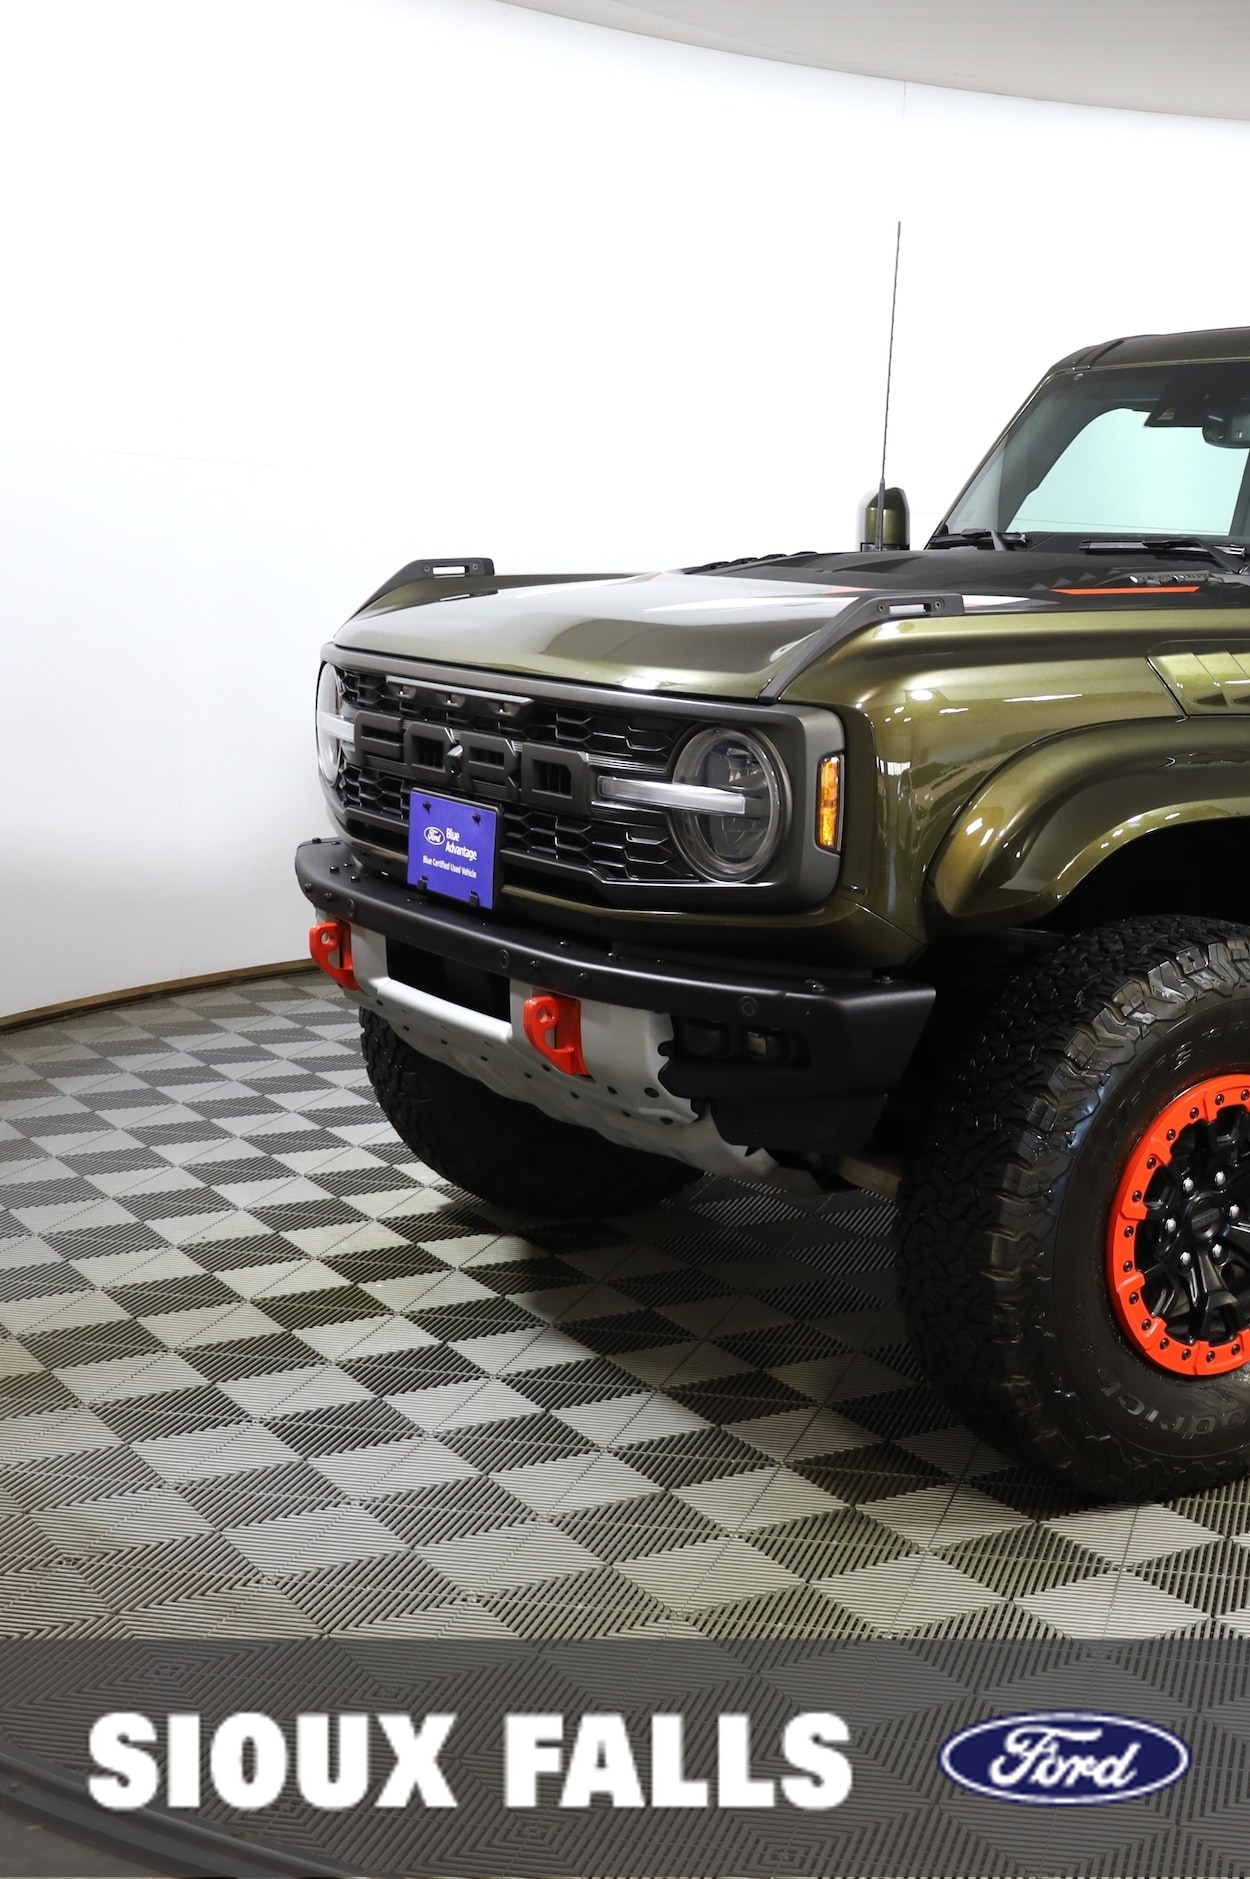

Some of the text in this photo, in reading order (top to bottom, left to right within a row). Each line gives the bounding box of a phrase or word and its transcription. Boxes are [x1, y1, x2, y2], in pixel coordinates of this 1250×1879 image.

[354, 711, 592, 818] FORD
[426, 828, 442, 843] Ford
[446, 827, 460, 842] Blue
[445, 841, 478, 861] Advantage
[422, 855, 478, 879] Blue Certified Used Vehicle
